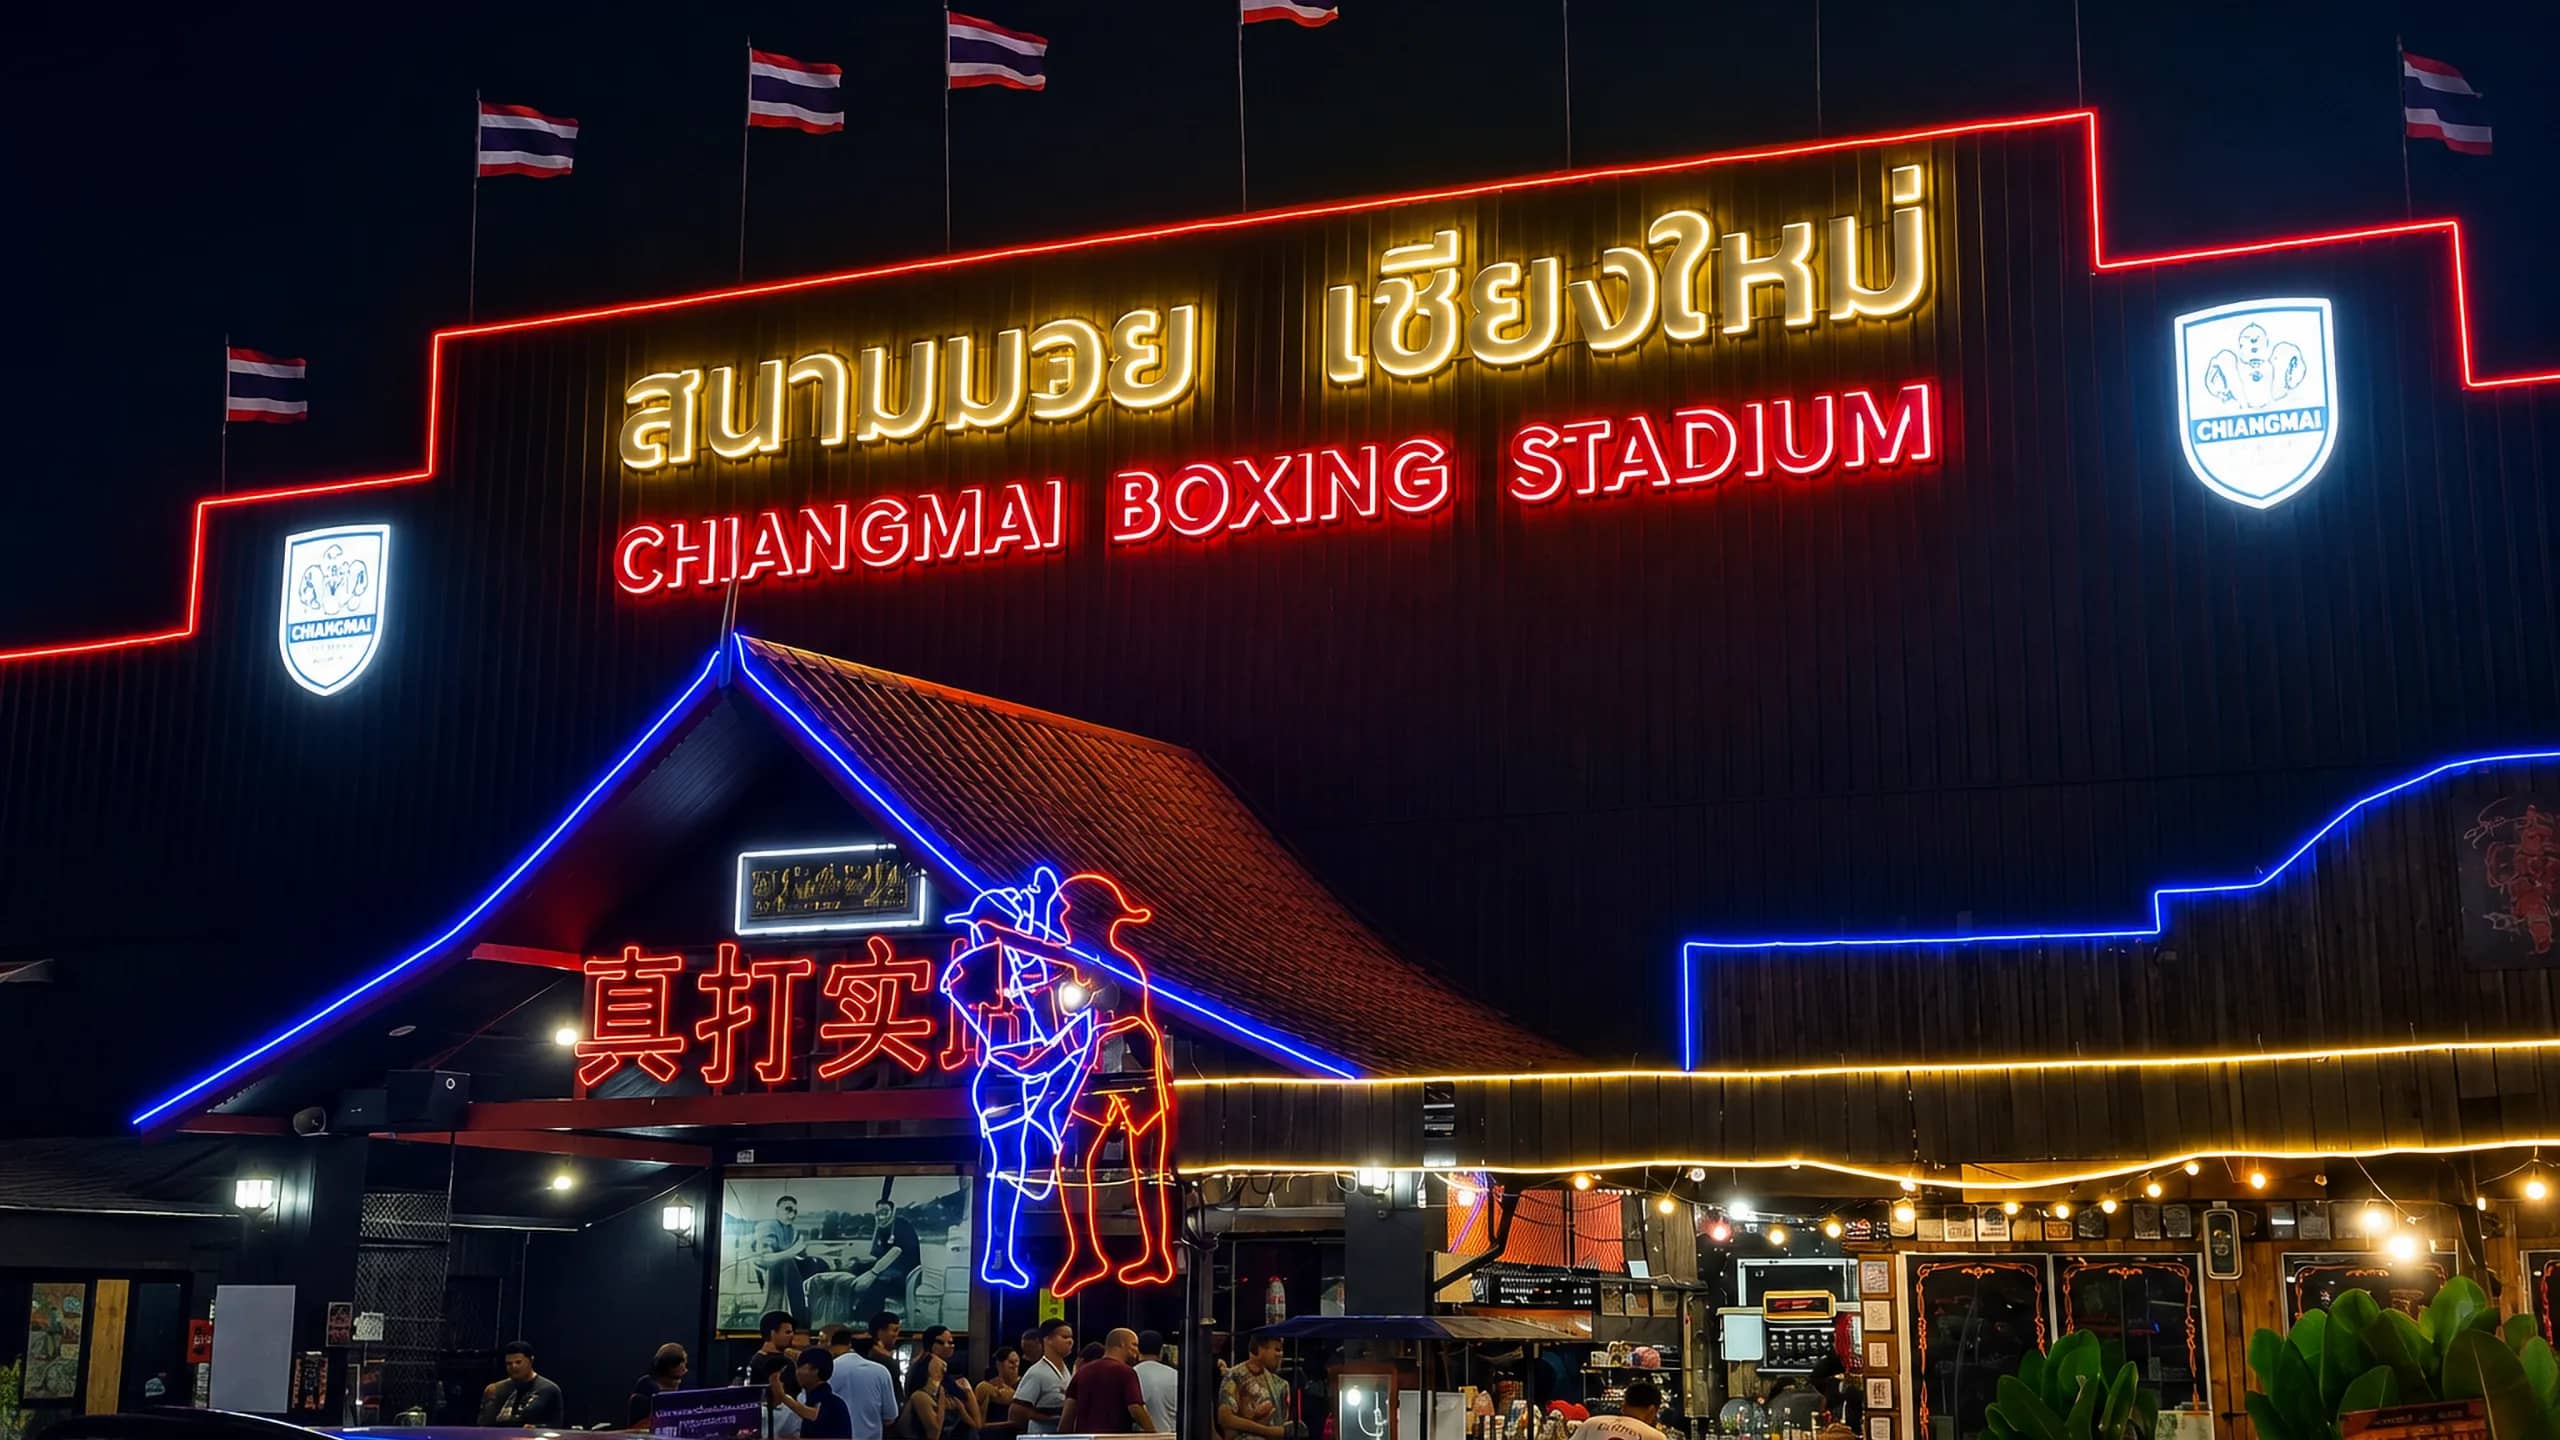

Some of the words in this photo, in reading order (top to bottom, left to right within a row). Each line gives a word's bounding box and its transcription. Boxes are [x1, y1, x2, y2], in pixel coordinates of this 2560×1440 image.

[1325, 163, 1926, 385] เชียงใหม่
[2196, 409, 2322, 441] CHIANGMAI
[614, 479, 1065, 595] CHIANGMAI
[1111, 437, 1449, 543] BOXING
[1509, 384, 1933, 502] STADIUM
[291, 617, 372, 641] CHIANGMAI
